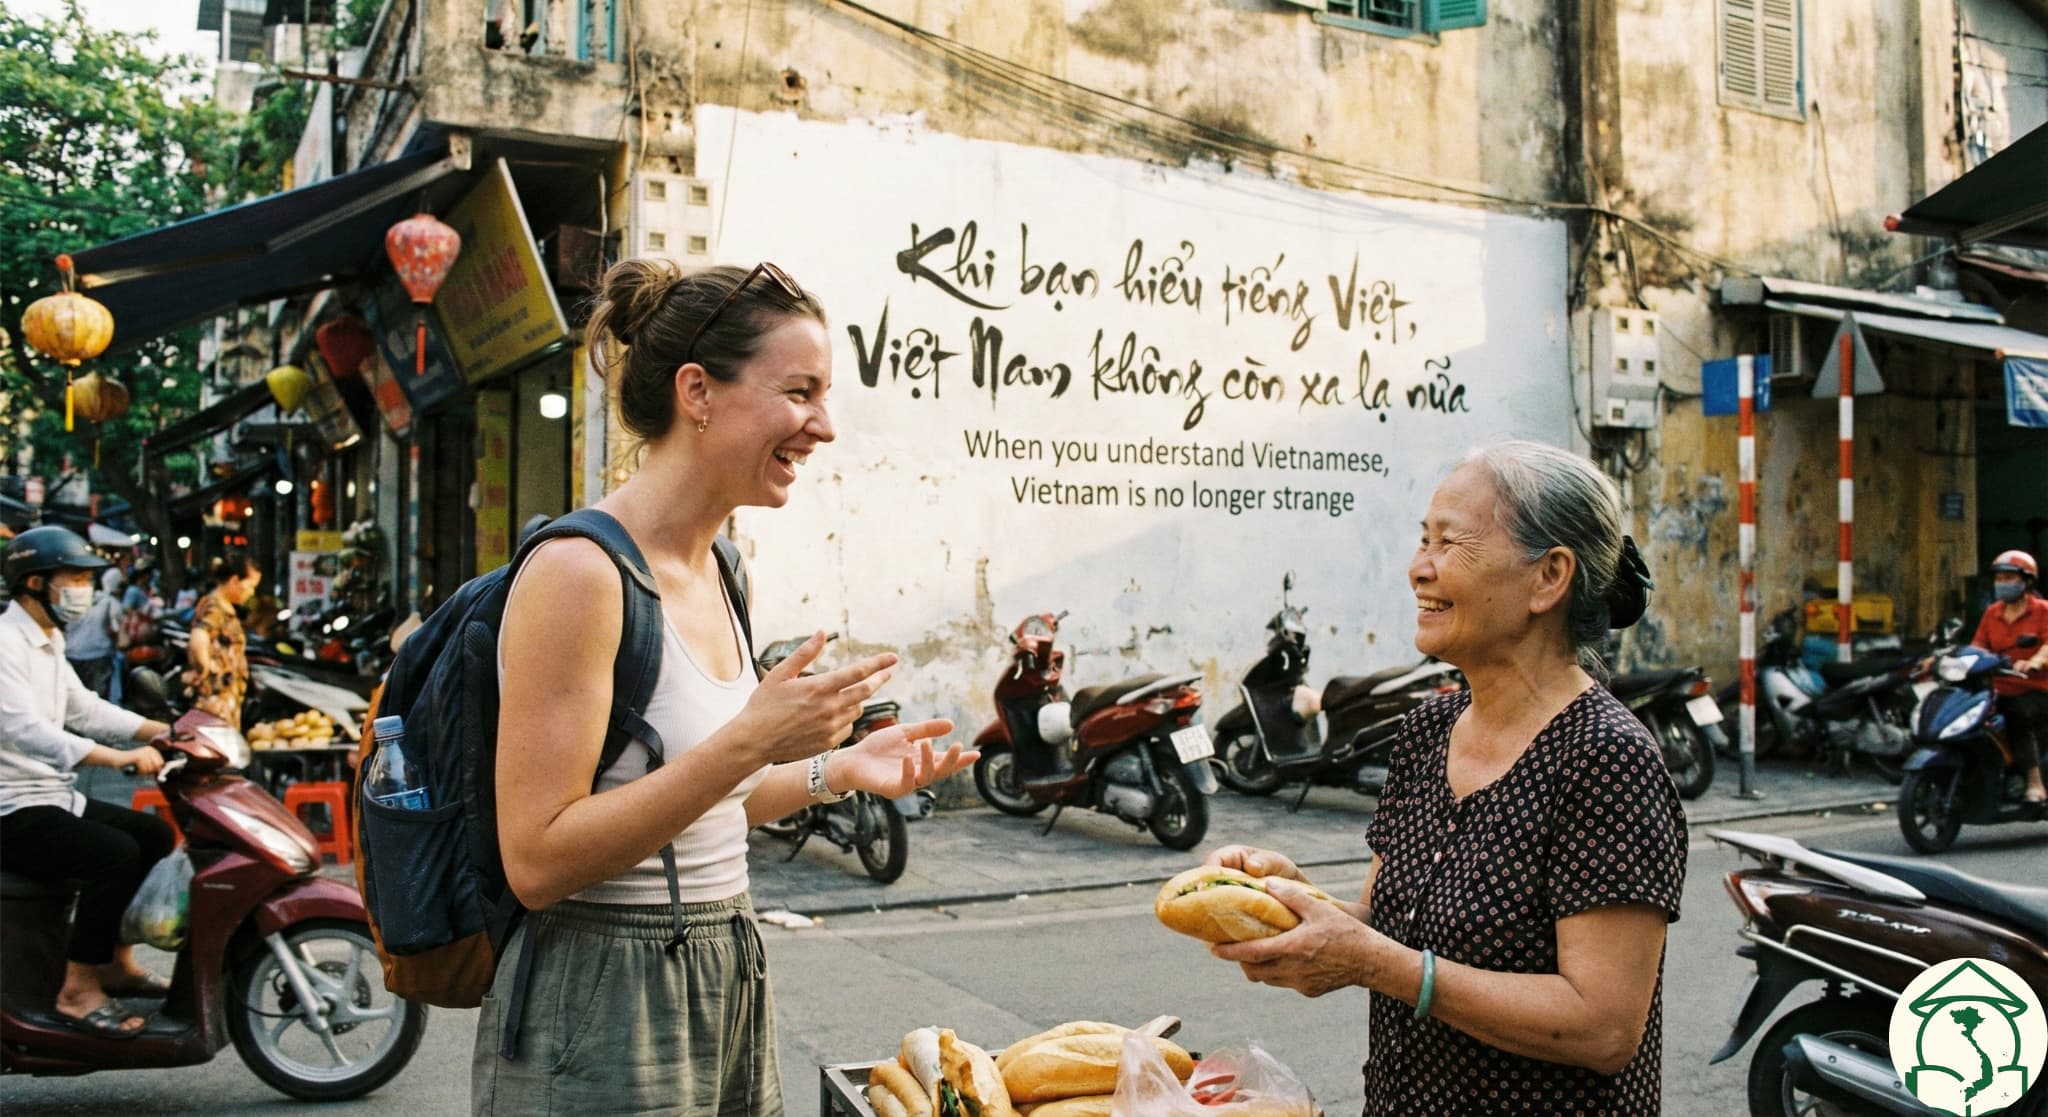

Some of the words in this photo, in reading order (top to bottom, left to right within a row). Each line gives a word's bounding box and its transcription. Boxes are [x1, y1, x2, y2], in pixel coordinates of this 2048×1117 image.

[896, 220, 1010, 311] Khi
[1020, 222, 1099, 312] bạn
[1113, 238, 1202, 312] hiểu
[1222, 253, 1317, 352] tiếng
[1328, 250, 1416, 344] Việt,
[846, 297, 960, 399] Việt
[969, 316, 1072, 411] Nam
[1088, 328, 1213, 431] không
[1222, 356, 1284, 402] còn
[1300, 374, 1343, 414] xa
[1354, 349, 1393, 423] lạ
[1406, 356, 1470, 415] nữa
[964, 429, 1042, 460] When
[1052, 440, 1097, 468] you
[1108, 437, 1245, 468] understand
[1252, 441, 1390, 477] Vietnamese,
[1011, 476, 1119, 506] Vietnam
[1128, 480, 1147, 507] is
[1154, 487, 1185, 508] no
[1193, 480, 1267, 516] longer
[1273, 482, 1355, 518] strange
